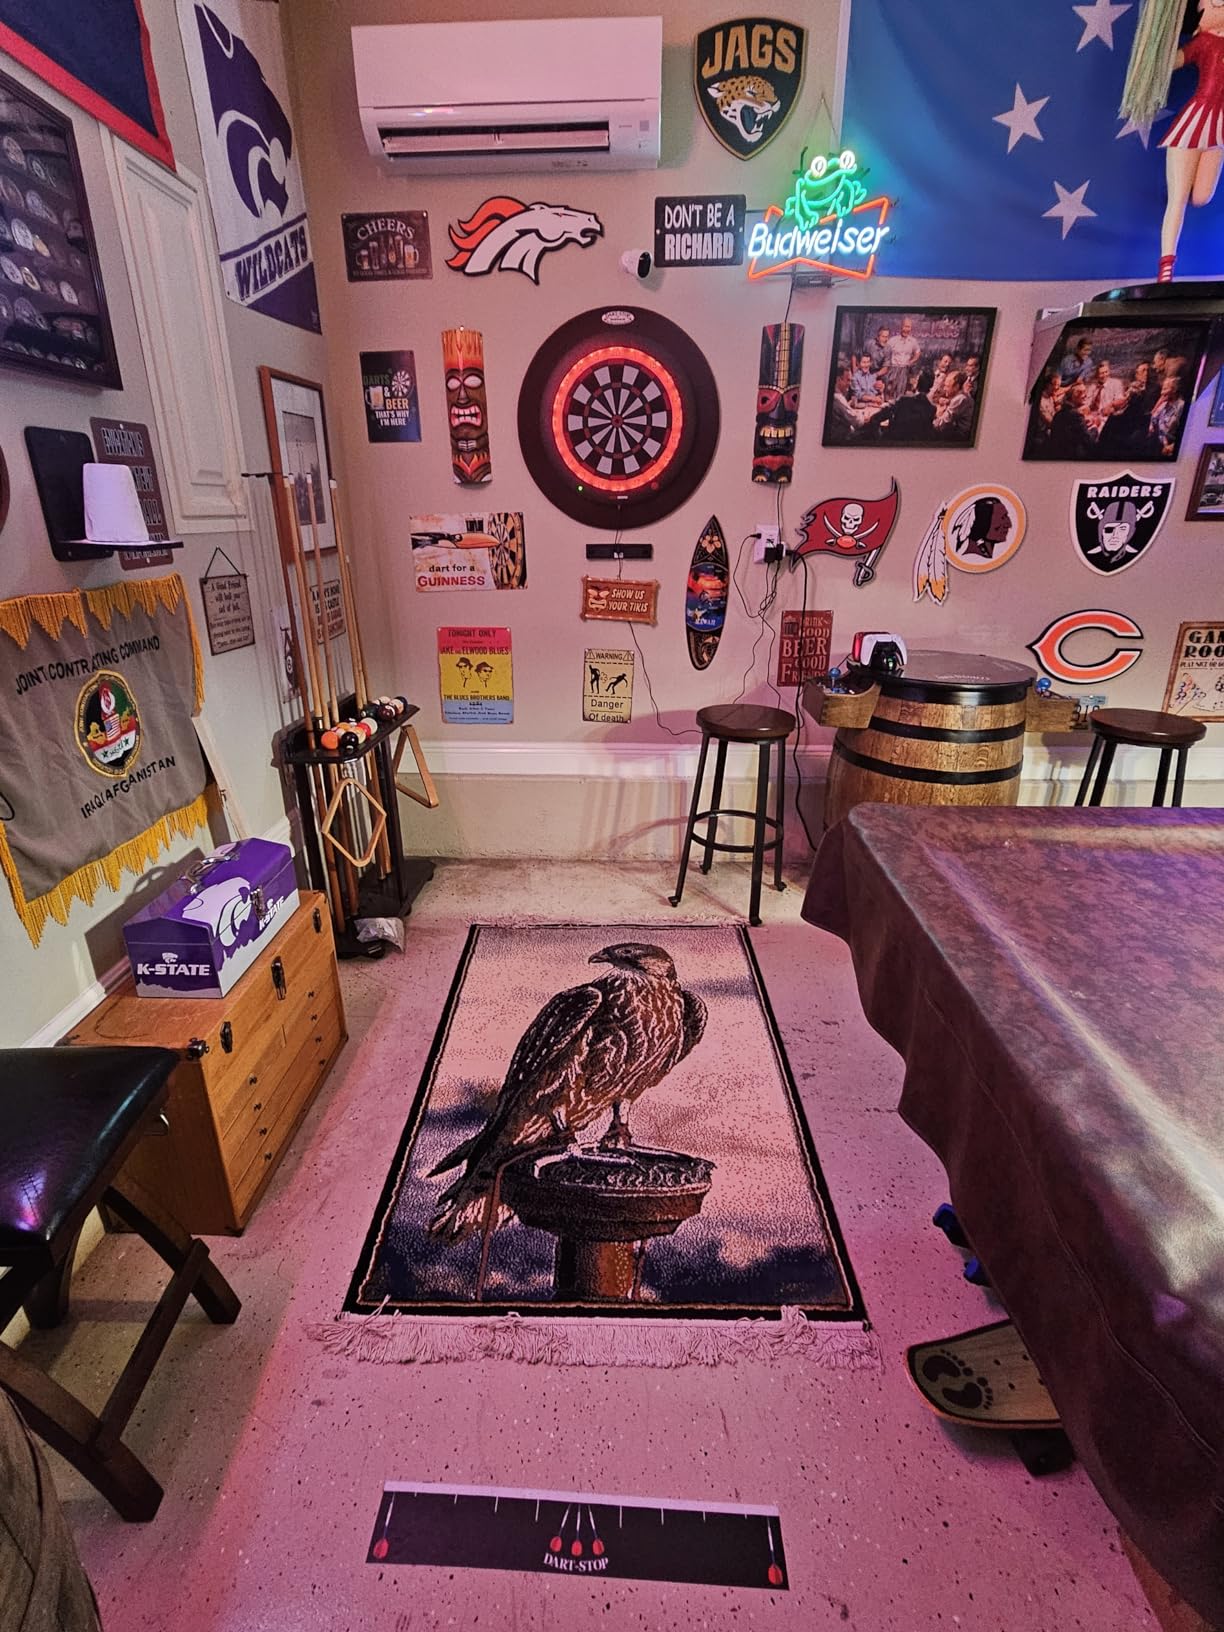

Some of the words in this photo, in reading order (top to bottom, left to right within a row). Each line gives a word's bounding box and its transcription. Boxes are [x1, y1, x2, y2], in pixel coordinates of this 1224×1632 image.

[702, 24, 797, 79] JAGS
[664, 203, 702, 229] DON'T
[707, 203, 721, 227] BE
[726, 204, 735, 226] A
[357, 218, 415, 240] CHEERS
[748, 219, 890, 258] Budweiser
[664, 232, 734, 260] RICHARD
[235, 225, 308, 301] WILDCATS
[363, 374, 390, 386] DARTS
[386, 398, 409, 410] BEER
[375, 410, 396, 419] THAT'S
[396, 410, 409, 418] WHY
[391, 418, 407, 426] HERE
[1087, 485, 1163, 498] RAIDERS
[429, 564, 449, 573] dart
[453, 564, 467, 572] for
[417, 576, 486, 587] GUINNESS
[611, 588, 633, 599] SHOW
[635, 590, 646, 600] US
[608, 601, 628, 612] YOUR
[629, 602, 649, 613] TIKIS
[595, 652, 623, 661] WARNING
[16, 665, 49, 695] JOINT
[119, 636, 160, 660] COMMAND
[591, 699, 624, 709] Danger
[589, 713, 599, 721] Of
[601, 714, 624, 722] death
[137, 963, 211, 976] K-STATE
[543, 1552, 609, 1572] DART-STOP
